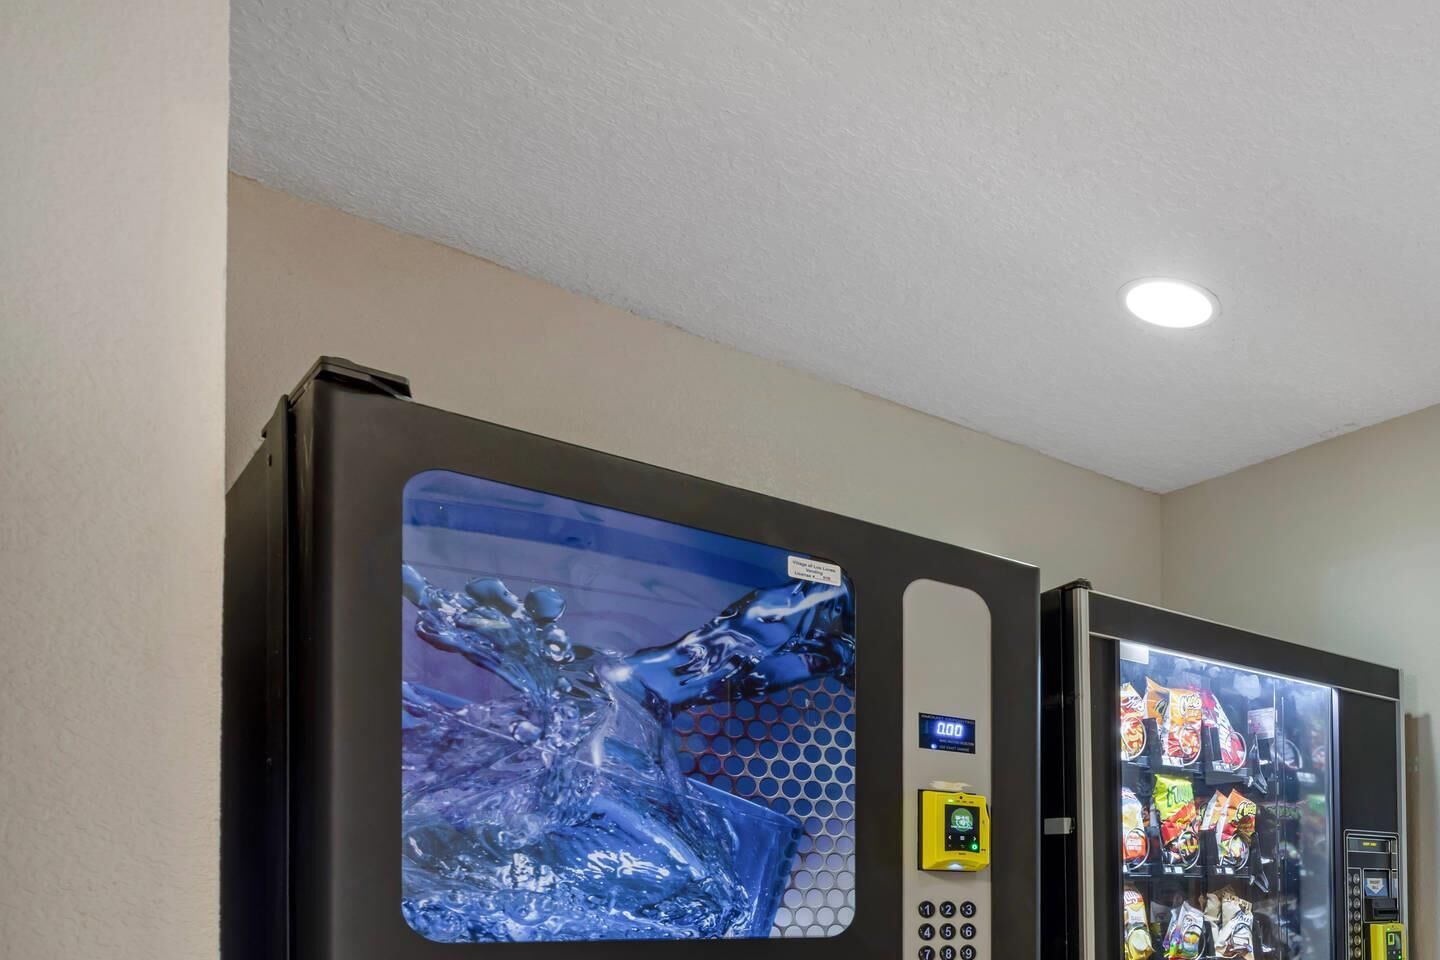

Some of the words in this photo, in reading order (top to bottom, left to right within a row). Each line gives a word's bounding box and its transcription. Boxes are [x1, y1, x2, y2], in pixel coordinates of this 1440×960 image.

[937, 722, 963, 737] 0.00
[924, 904, 930, 916] 1
[945, 904, 952, 915] 2
[965, 904, 972, 915] 3
[924, 927, 931, 938] 4
[945, 926, 952, 937] 5
[965, 926, 972, 937] 6
[924, 949, 931, 960] 7
[945, 948, 952, 959] 8
[965, 948, 972, 959] 9
